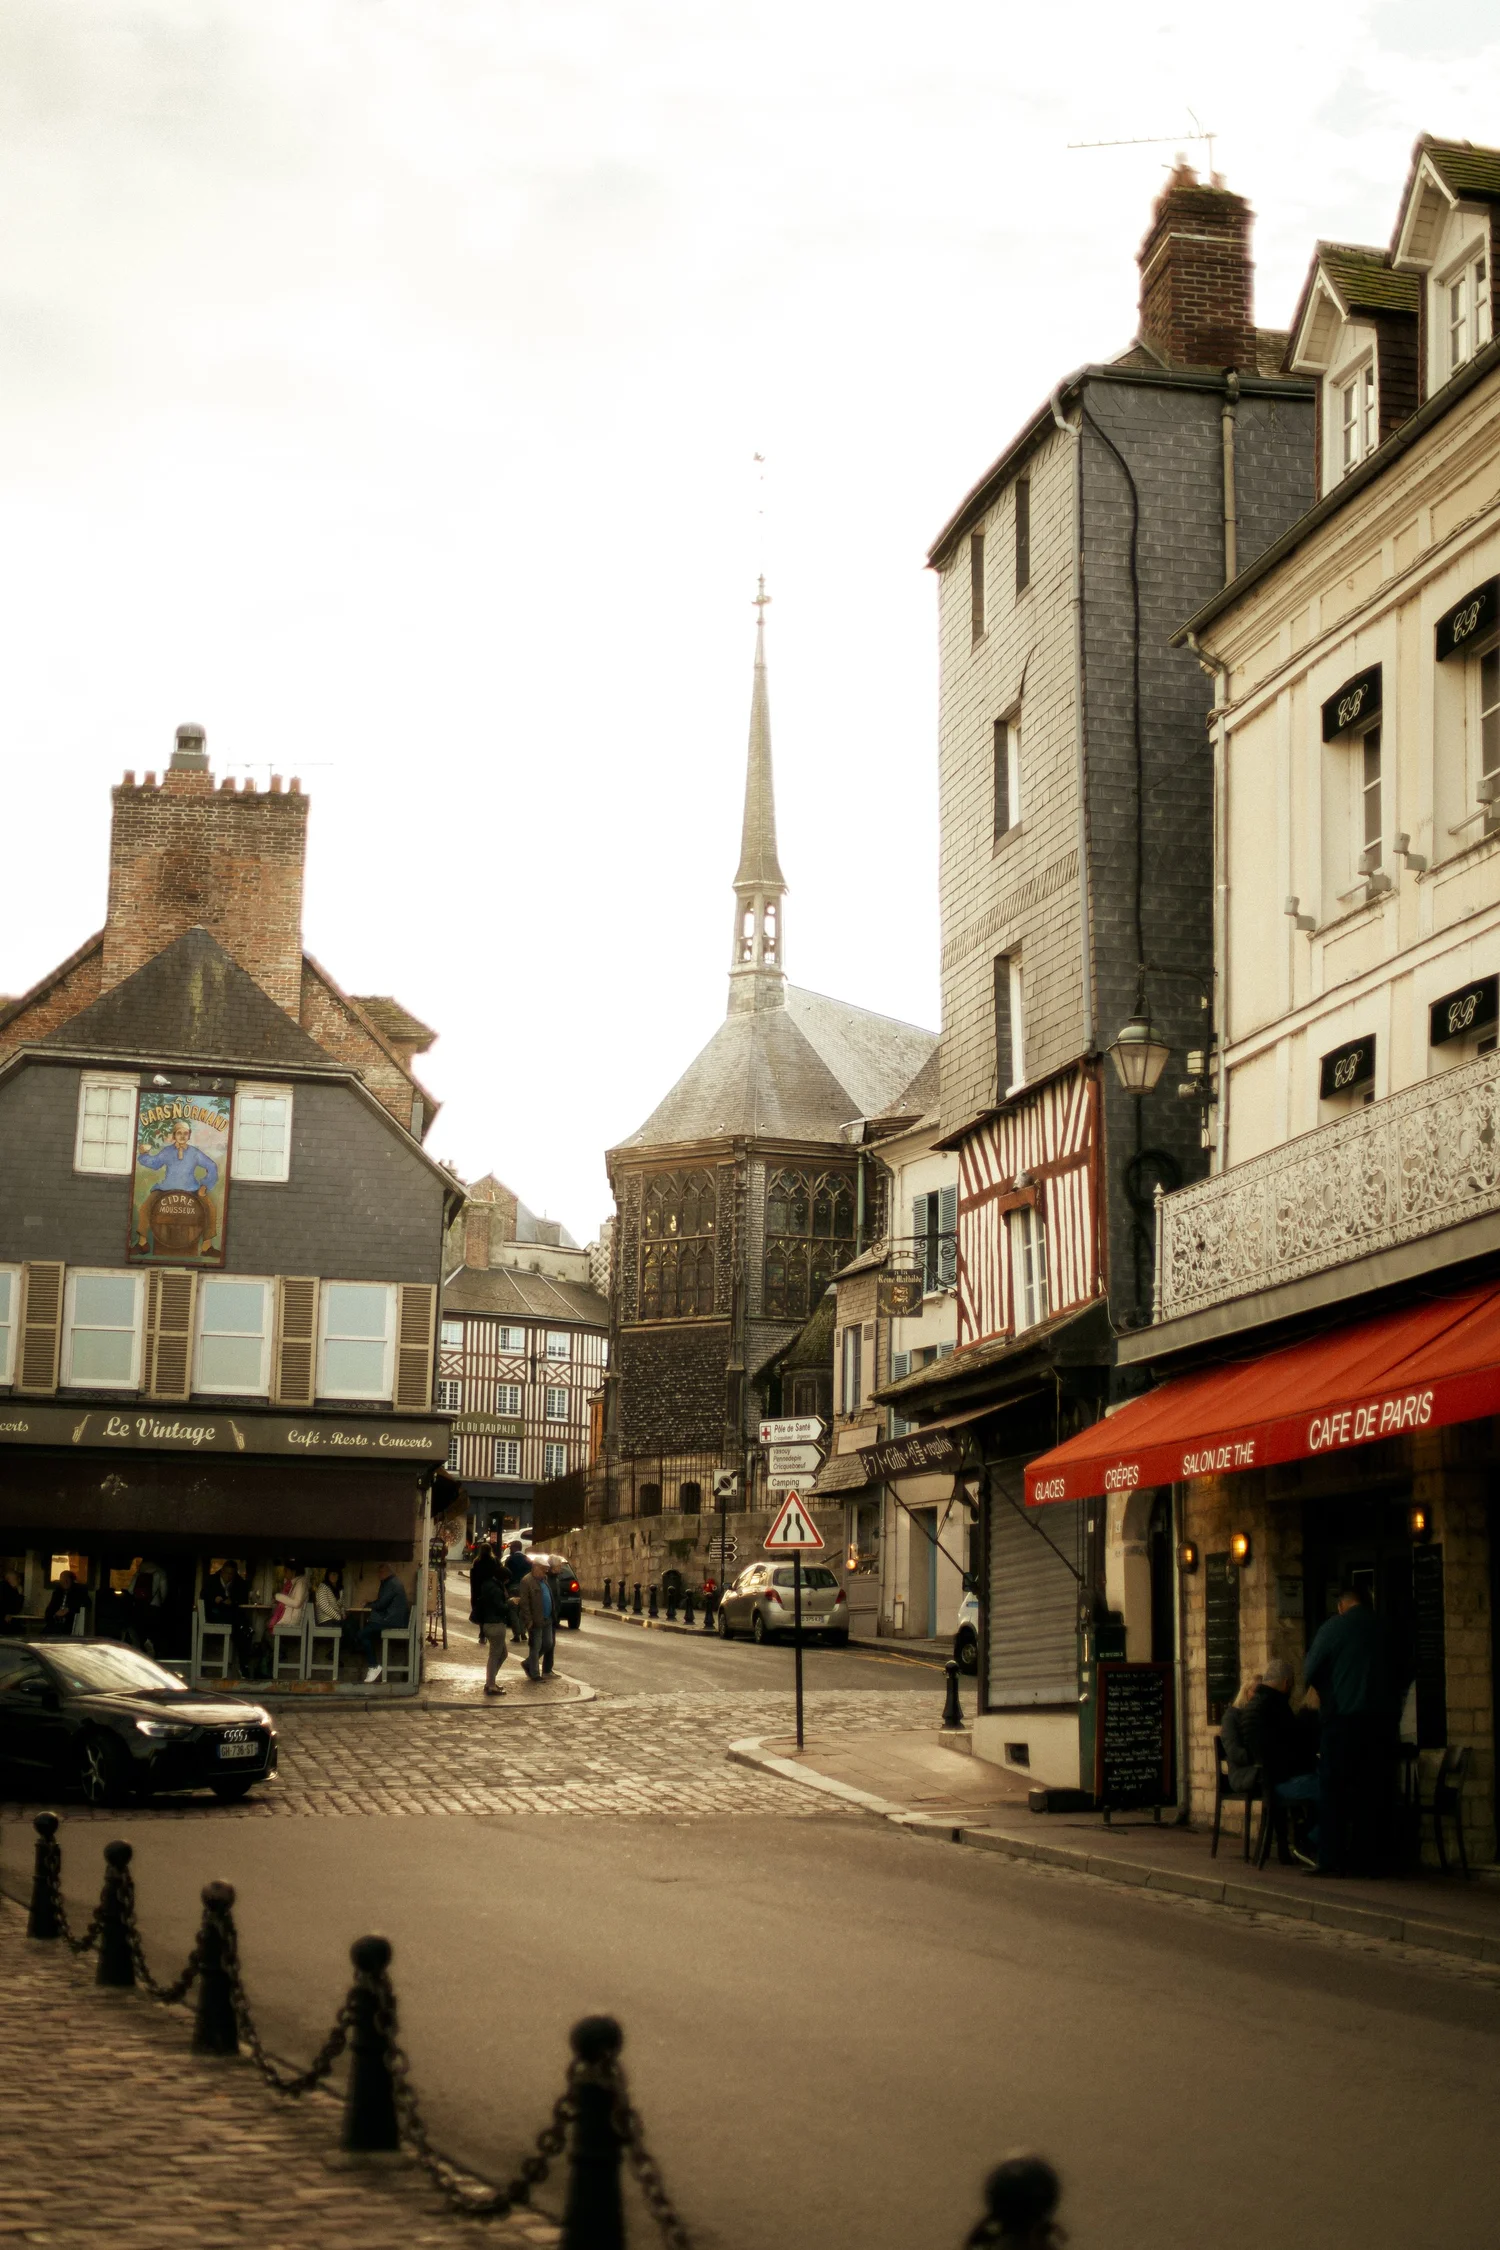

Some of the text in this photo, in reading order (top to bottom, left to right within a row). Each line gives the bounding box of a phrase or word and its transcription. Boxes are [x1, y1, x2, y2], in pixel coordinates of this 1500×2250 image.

[140, 1102, 229, 1132] GARS NORMAND
[159, 1206, 196, 1214] MOUSSEUX
[161, 1195, 195, 1206] CIDRE
[103, 1416, 216, 1446] Le Vintage
[467, 1422, 478, 1432] DU
[480, 1423, 516, 1434] DAUPHIN
[774, 1423, 811, 1433] Pôle de Santé
[1309, 1391, 1433, 1450] CAFE DE PARIS
[288, 1430, 432, 1448] Café Resto Concerts
[926, 1435, 953, 1459] regalos
[885, 1446, 907, 1470] Gifts
[907, 1441, 927, 1466] 선물
[1182, 1441, 1255, 1476] SALON DE THE
[772, 1478, 799, 1487] Camping
[1105, 1462, 1139, 1489] CRÊPES
[1035, 1478, 1065, 1500] GLACES
